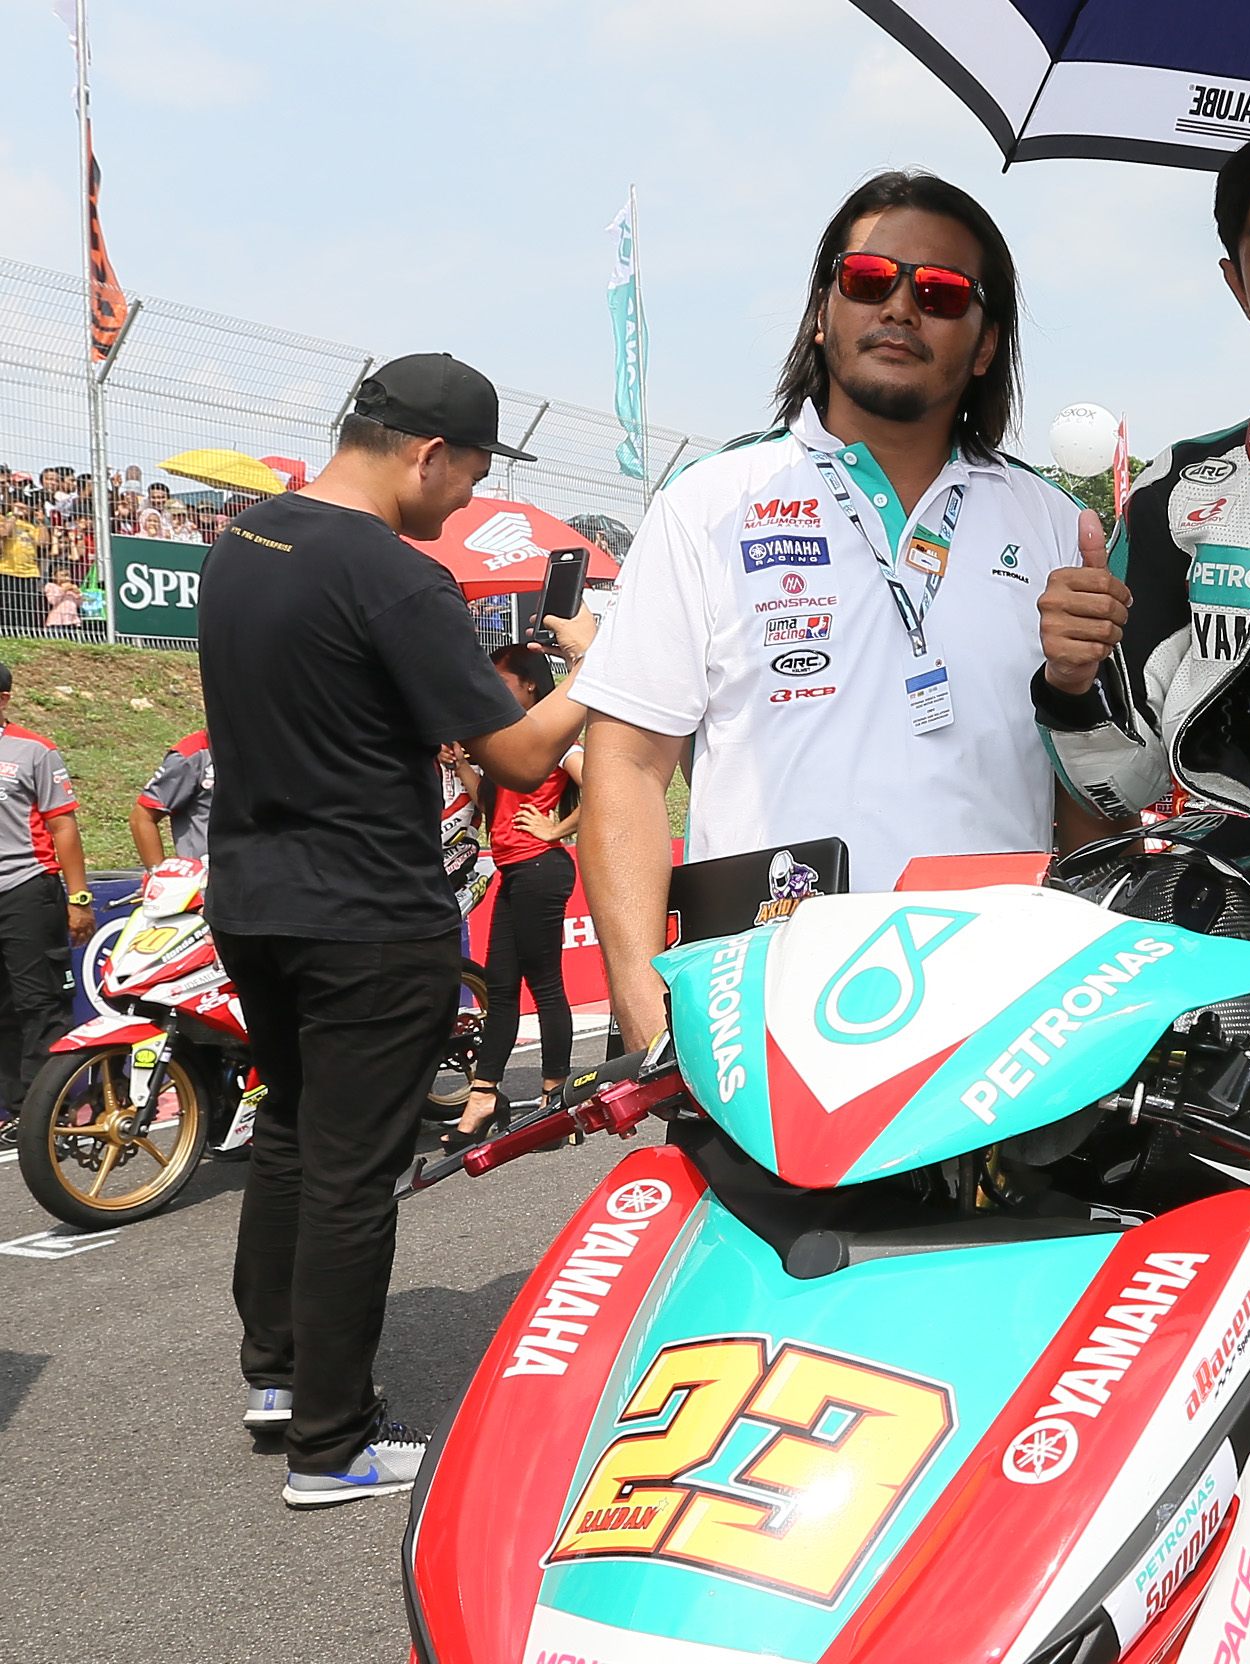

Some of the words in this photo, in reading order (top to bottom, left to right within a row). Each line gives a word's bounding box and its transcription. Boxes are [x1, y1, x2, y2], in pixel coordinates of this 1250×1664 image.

[765, 539, 822, 556] YAMAHA
[991, 568, 1030, 584] PETRONAS
[755, 595, 837, 613] MONSPACE
[768, 618, 797, 632] uma
[768, 628, 806, 641] racing
[780, 656, 819, 669] ARC
[796, 686, 836, 698] RCB
[161, 933, 196, 964] Honda
[707, 933, 754, 1104] PETRONAS
[959, 937, 1176, 1127] PETRONAS
[502, 1219, 650, 1379] YAMAHA
[1035, 1251, 1211, 1419] YAMAHA
[538, 1331, 960, 1610] 23
[575, 1506, 660, 1536] RAMDAN
[1134, 1473, 1216, 1593] PETRONAS
[1145, 1497, 1221, 1624] Sprinta
